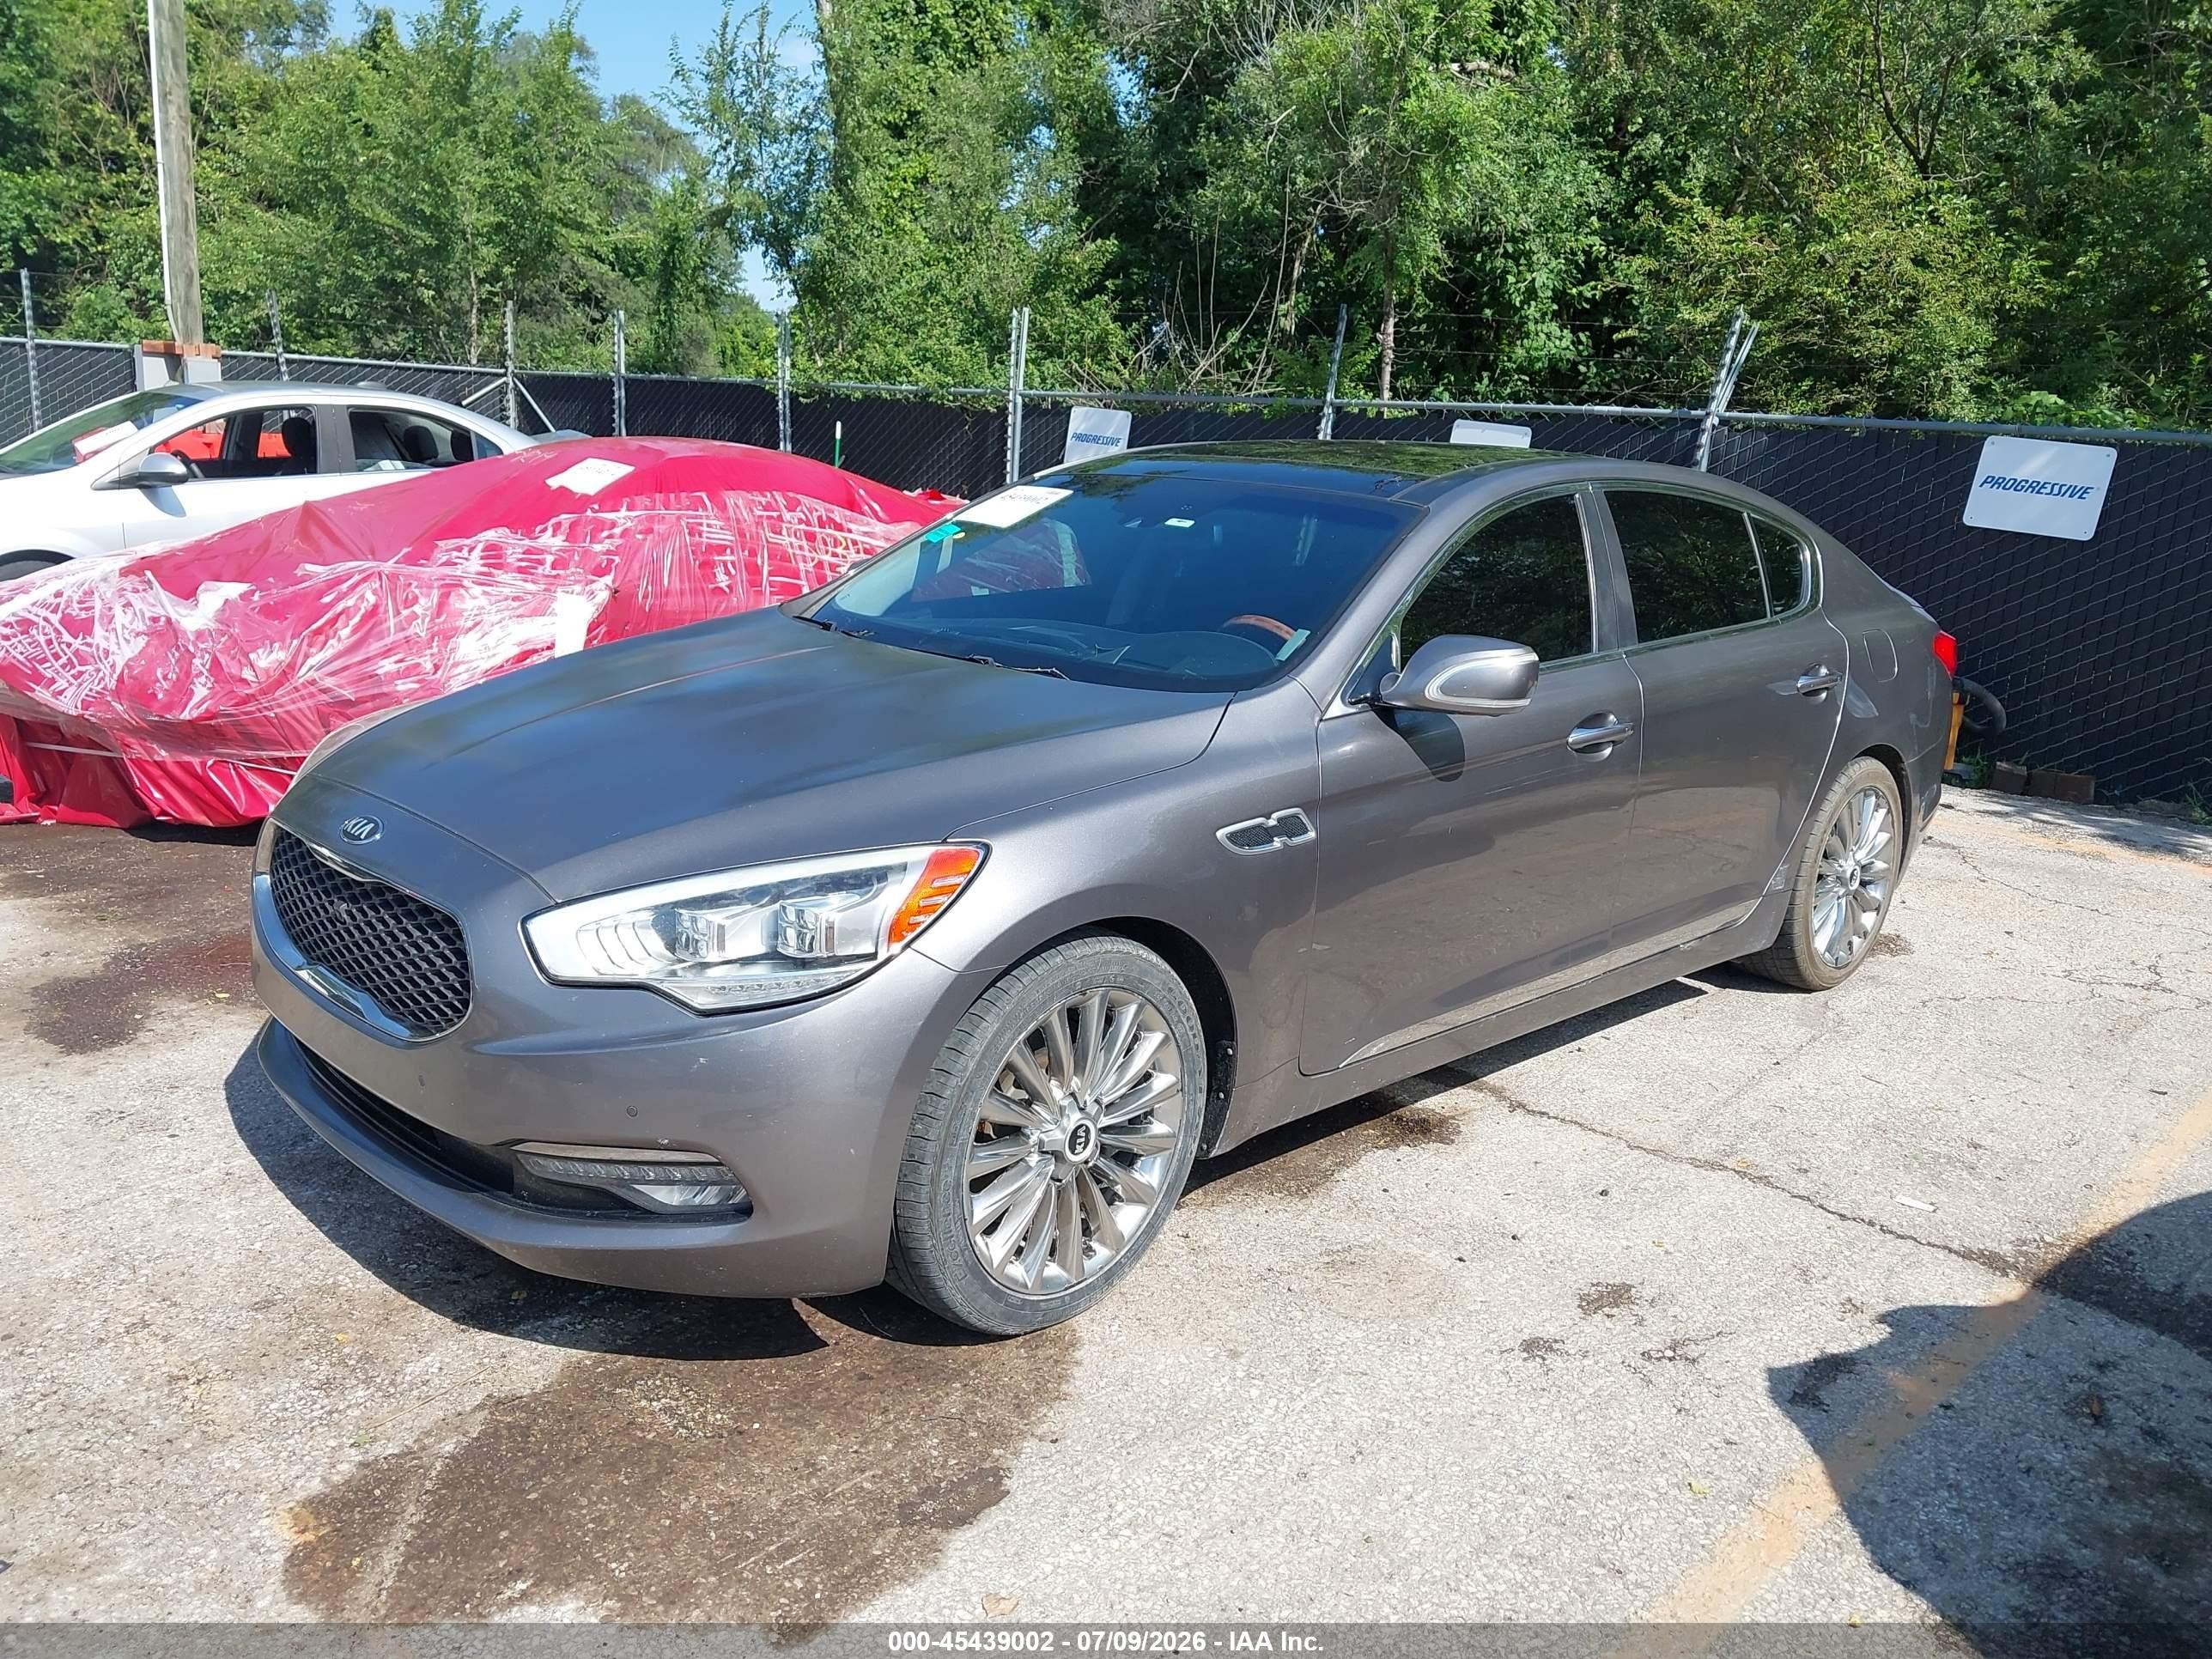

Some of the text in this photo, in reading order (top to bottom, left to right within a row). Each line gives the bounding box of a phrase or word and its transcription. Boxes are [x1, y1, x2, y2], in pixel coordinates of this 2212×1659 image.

[1070, 432, 1122, 447] PROGRESSIVE
[1979, 475, 2094, 500] PROGRESSIVE
[343, 817, 375, 839] KIA
[1074, 1125, 1086, 1154] KIA
